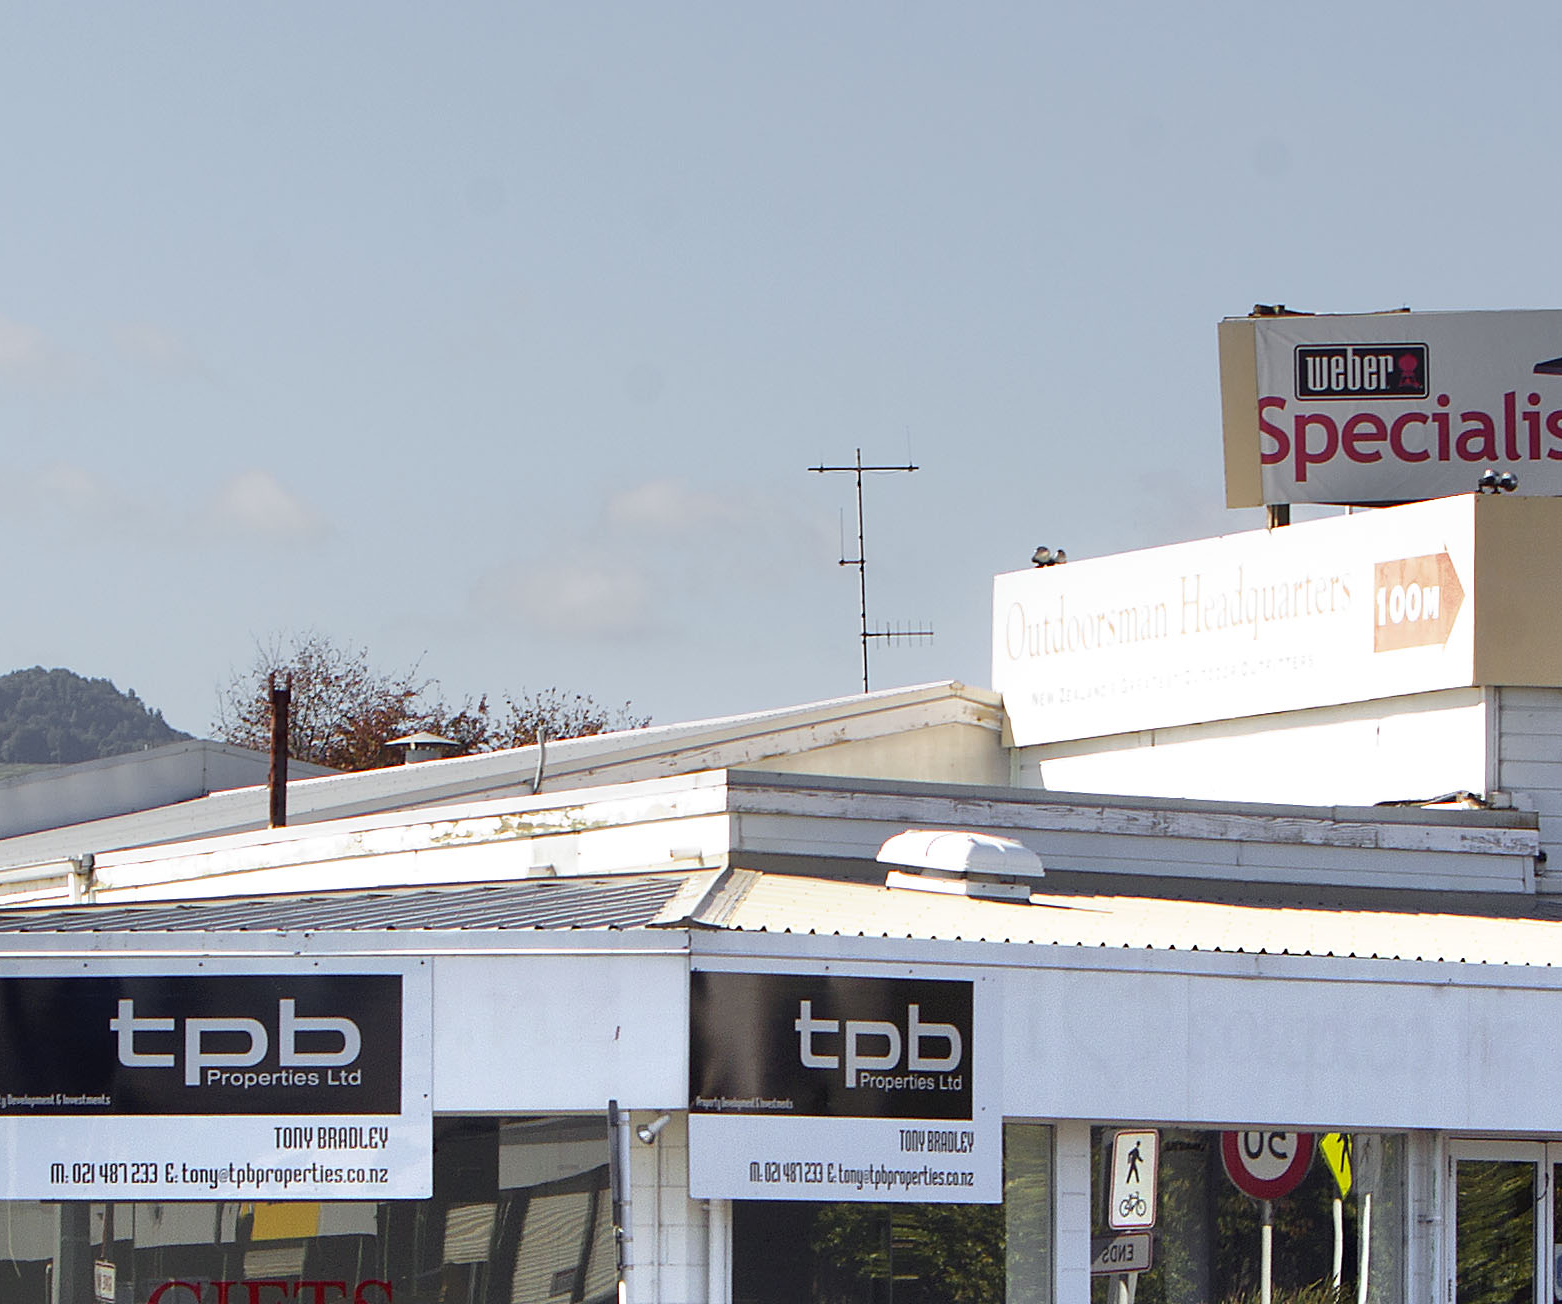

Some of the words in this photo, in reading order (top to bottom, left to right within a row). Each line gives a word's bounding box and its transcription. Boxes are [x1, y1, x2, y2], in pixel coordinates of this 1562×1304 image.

[1305, 349, 1394, 390] weber
[1005, 594, 1168, 661] Outdoorsman
[1180, 564, 1352, 640] Headquarters
[1377, 582, 1441, 627] 100M
[110, 998, 362, 1086] tpb
[794, 1000, 963, 1089] tpb
[206, 1069, 319, 1089] Properties
[327, 1068, 362, 1086] Ltd
[860, 1072, 935, 1092] Properties
[939, 1073, 963, 1090] Ltd
[274, 1126, 313, 1149] TONY
[318, 1126, 388, 1149] BRADLEY
[899, 1130, 925, 1152] TONY
[927, 1130, 974, 1153] BRADLEY
[50, 1162, 69, 1184] M:
[72, 1162, 95, 1184] 021
[99, 1162, 127, 1184] 487
[131, 1162, 158, 1184] 233
[181, 1162, 388, 1189] tony@tpbproperties.co.nz
[764, 1162, 780, 1183] 021
[783, 1162, 802, 1183] 487
[804, 1162, 823, 1184] 233
